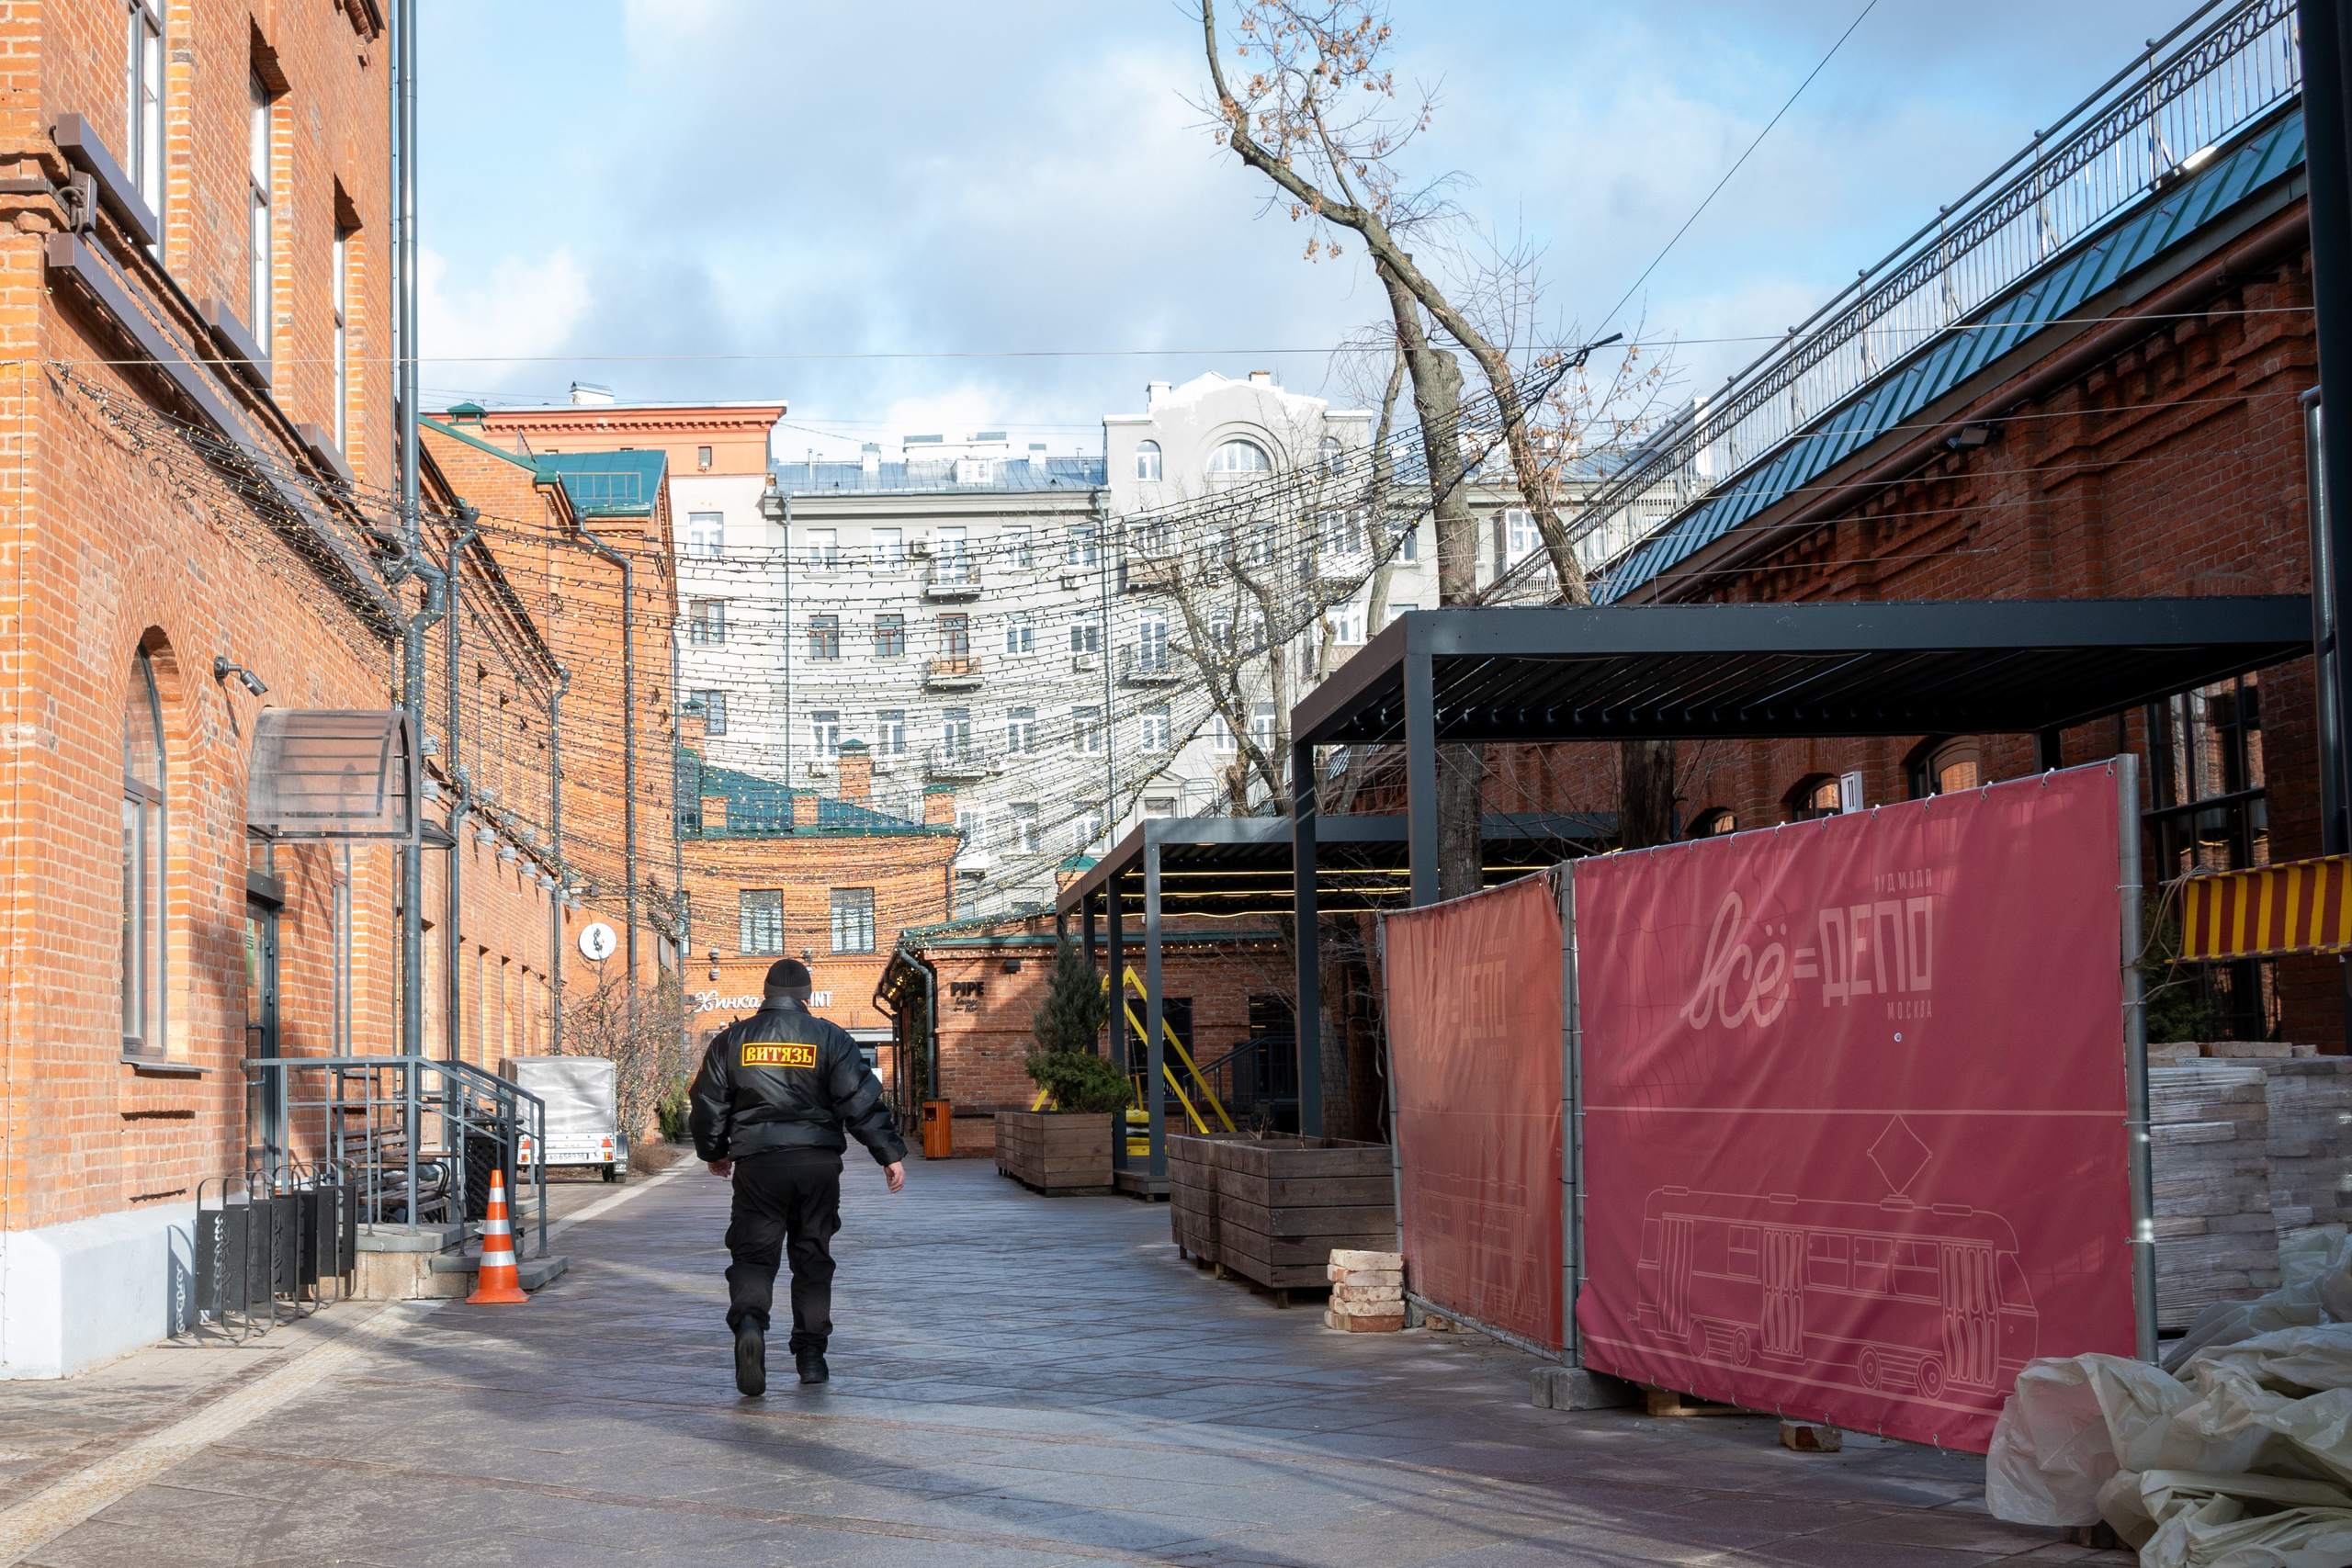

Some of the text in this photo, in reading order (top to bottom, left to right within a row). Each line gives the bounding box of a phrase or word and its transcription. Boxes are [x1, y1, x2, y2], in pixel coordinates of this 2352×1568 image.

[1847, 779, 1855, 808] 11
[950, 981, 985, 998] PIPE
[693, 990, 832, 1012] Хинка INT
[1887, 999, 1932, 1020] МОСКВА
[745, 1046, 813, 1064] ВИТЯЗЬ
